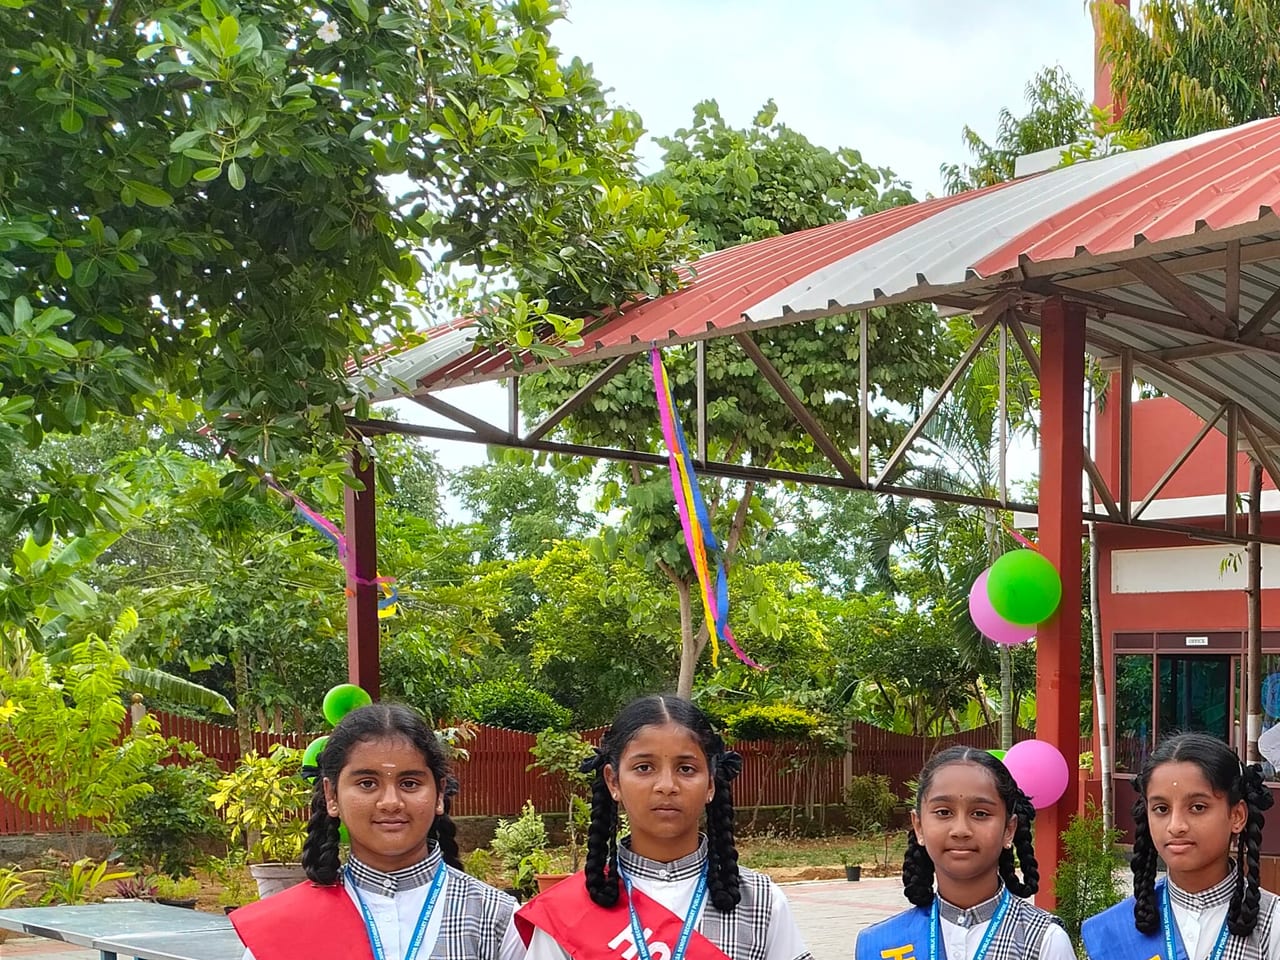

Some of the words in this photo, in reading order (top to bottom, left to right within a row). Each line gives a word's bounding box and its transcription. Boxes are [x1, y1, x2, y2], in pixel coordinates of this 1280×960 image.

[691, 892, 701, 909] PUBLIC
[1163, 923, 1171, 940] PUBLIC
[1218, 930, 1228, 948] PUBLIC
[979, 936, 991, 954] PUBLIC
